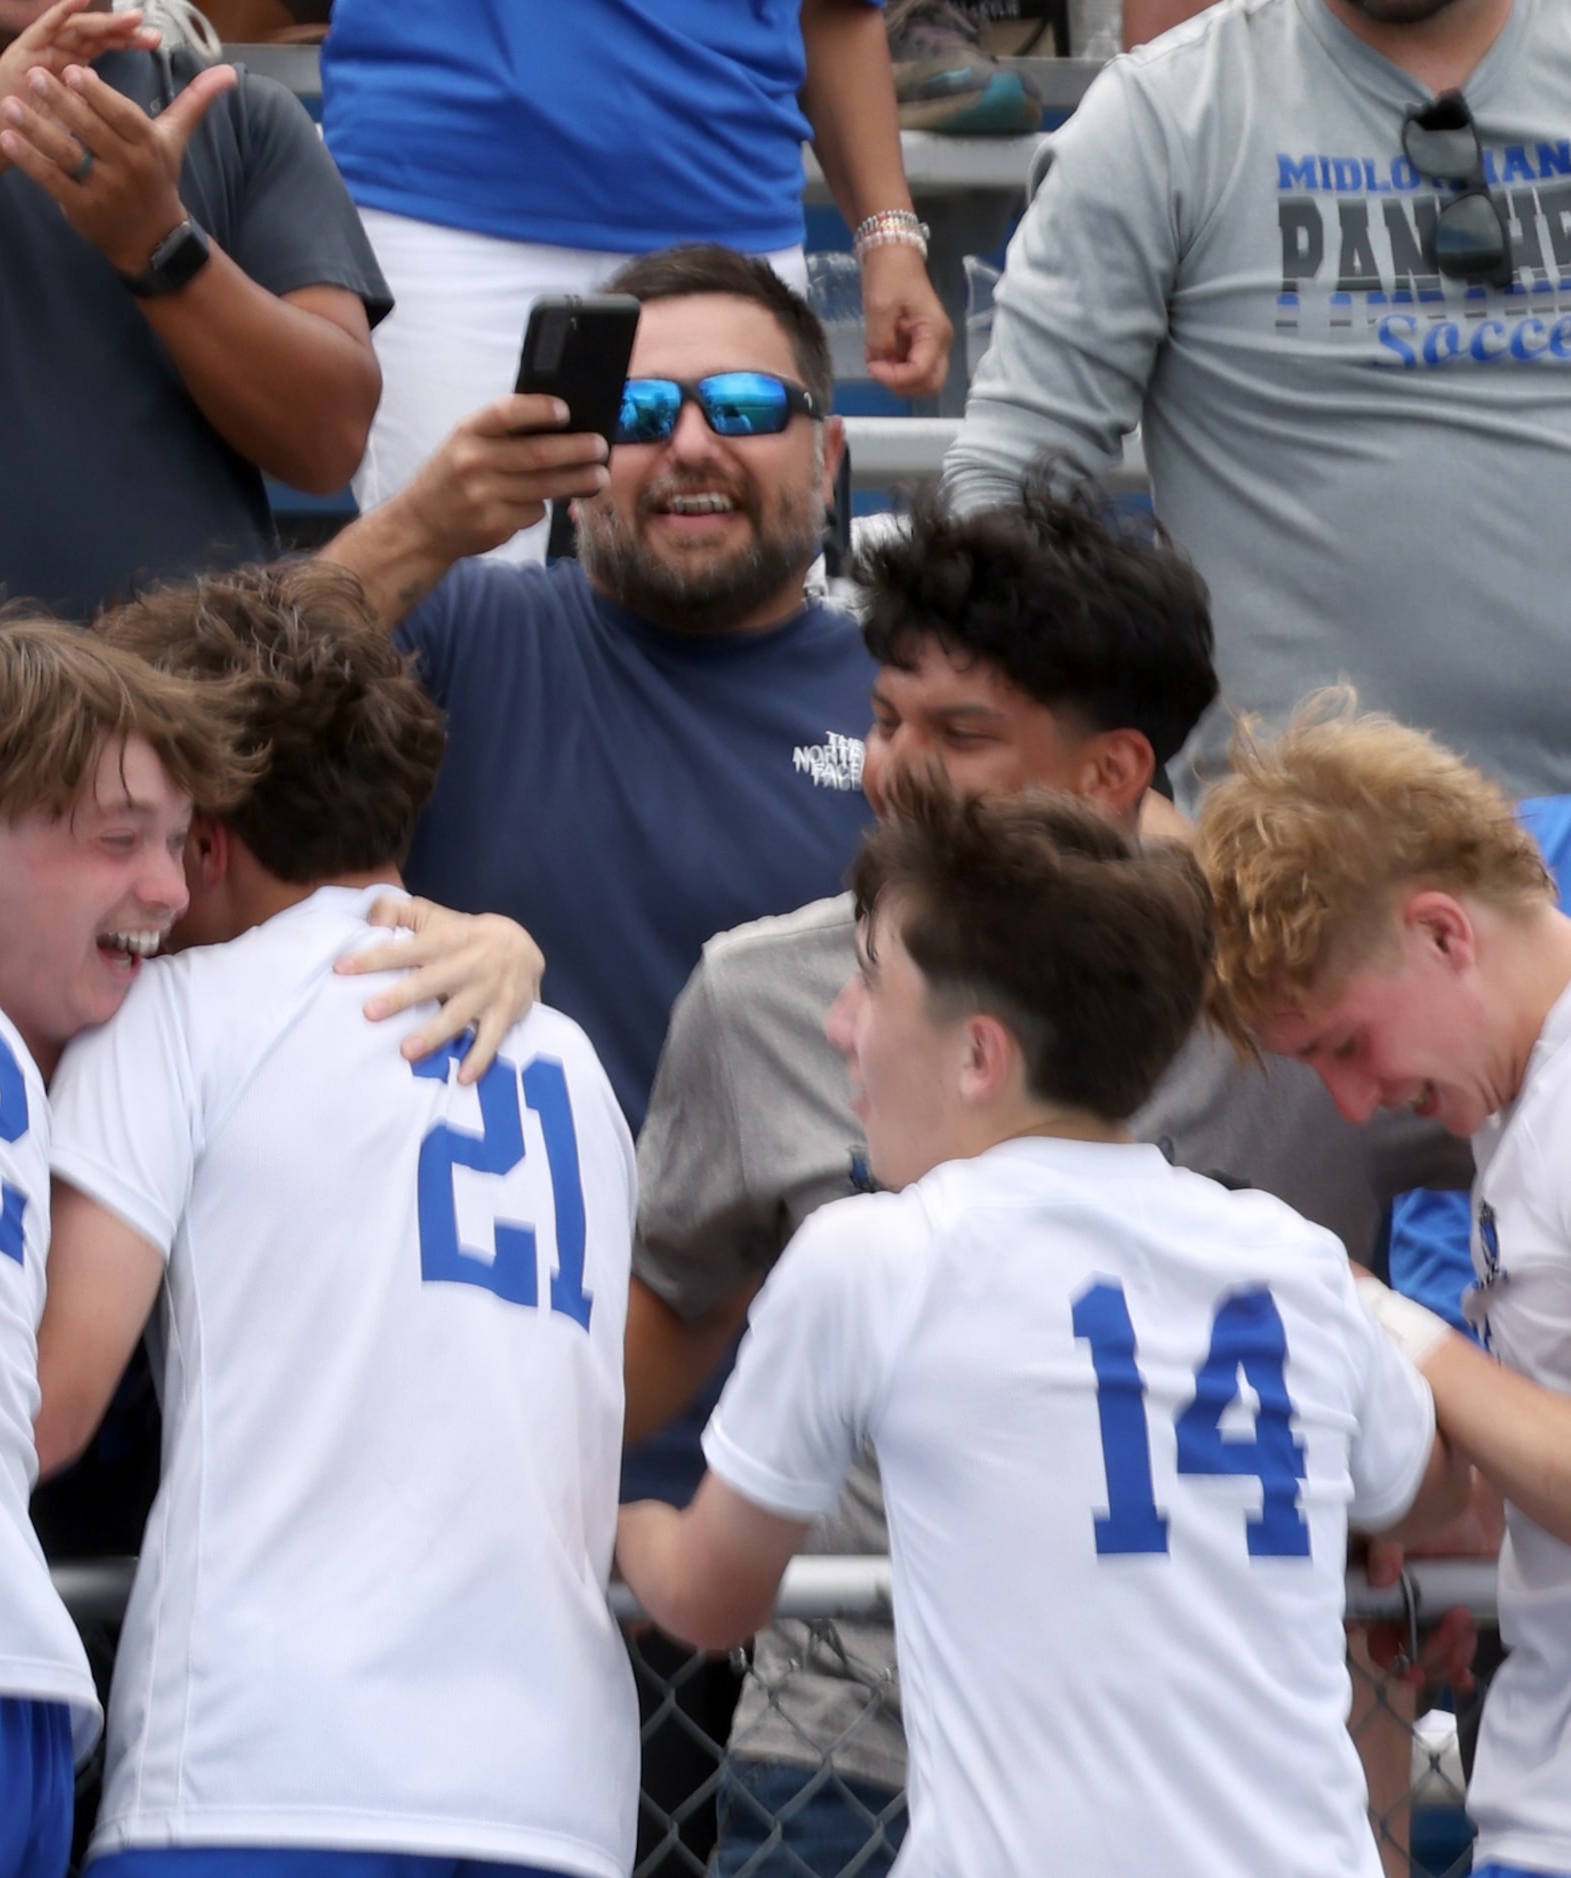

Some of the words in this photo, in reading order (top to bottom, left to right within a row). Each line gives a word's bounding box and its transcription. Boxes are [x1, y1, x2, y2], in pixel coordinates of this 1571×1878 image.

[1276, 139, 1571, 192] MIDLOIAN
[410, 1025, 595, 1335] 21
[1069, 1272, 1314, 1560] 14
